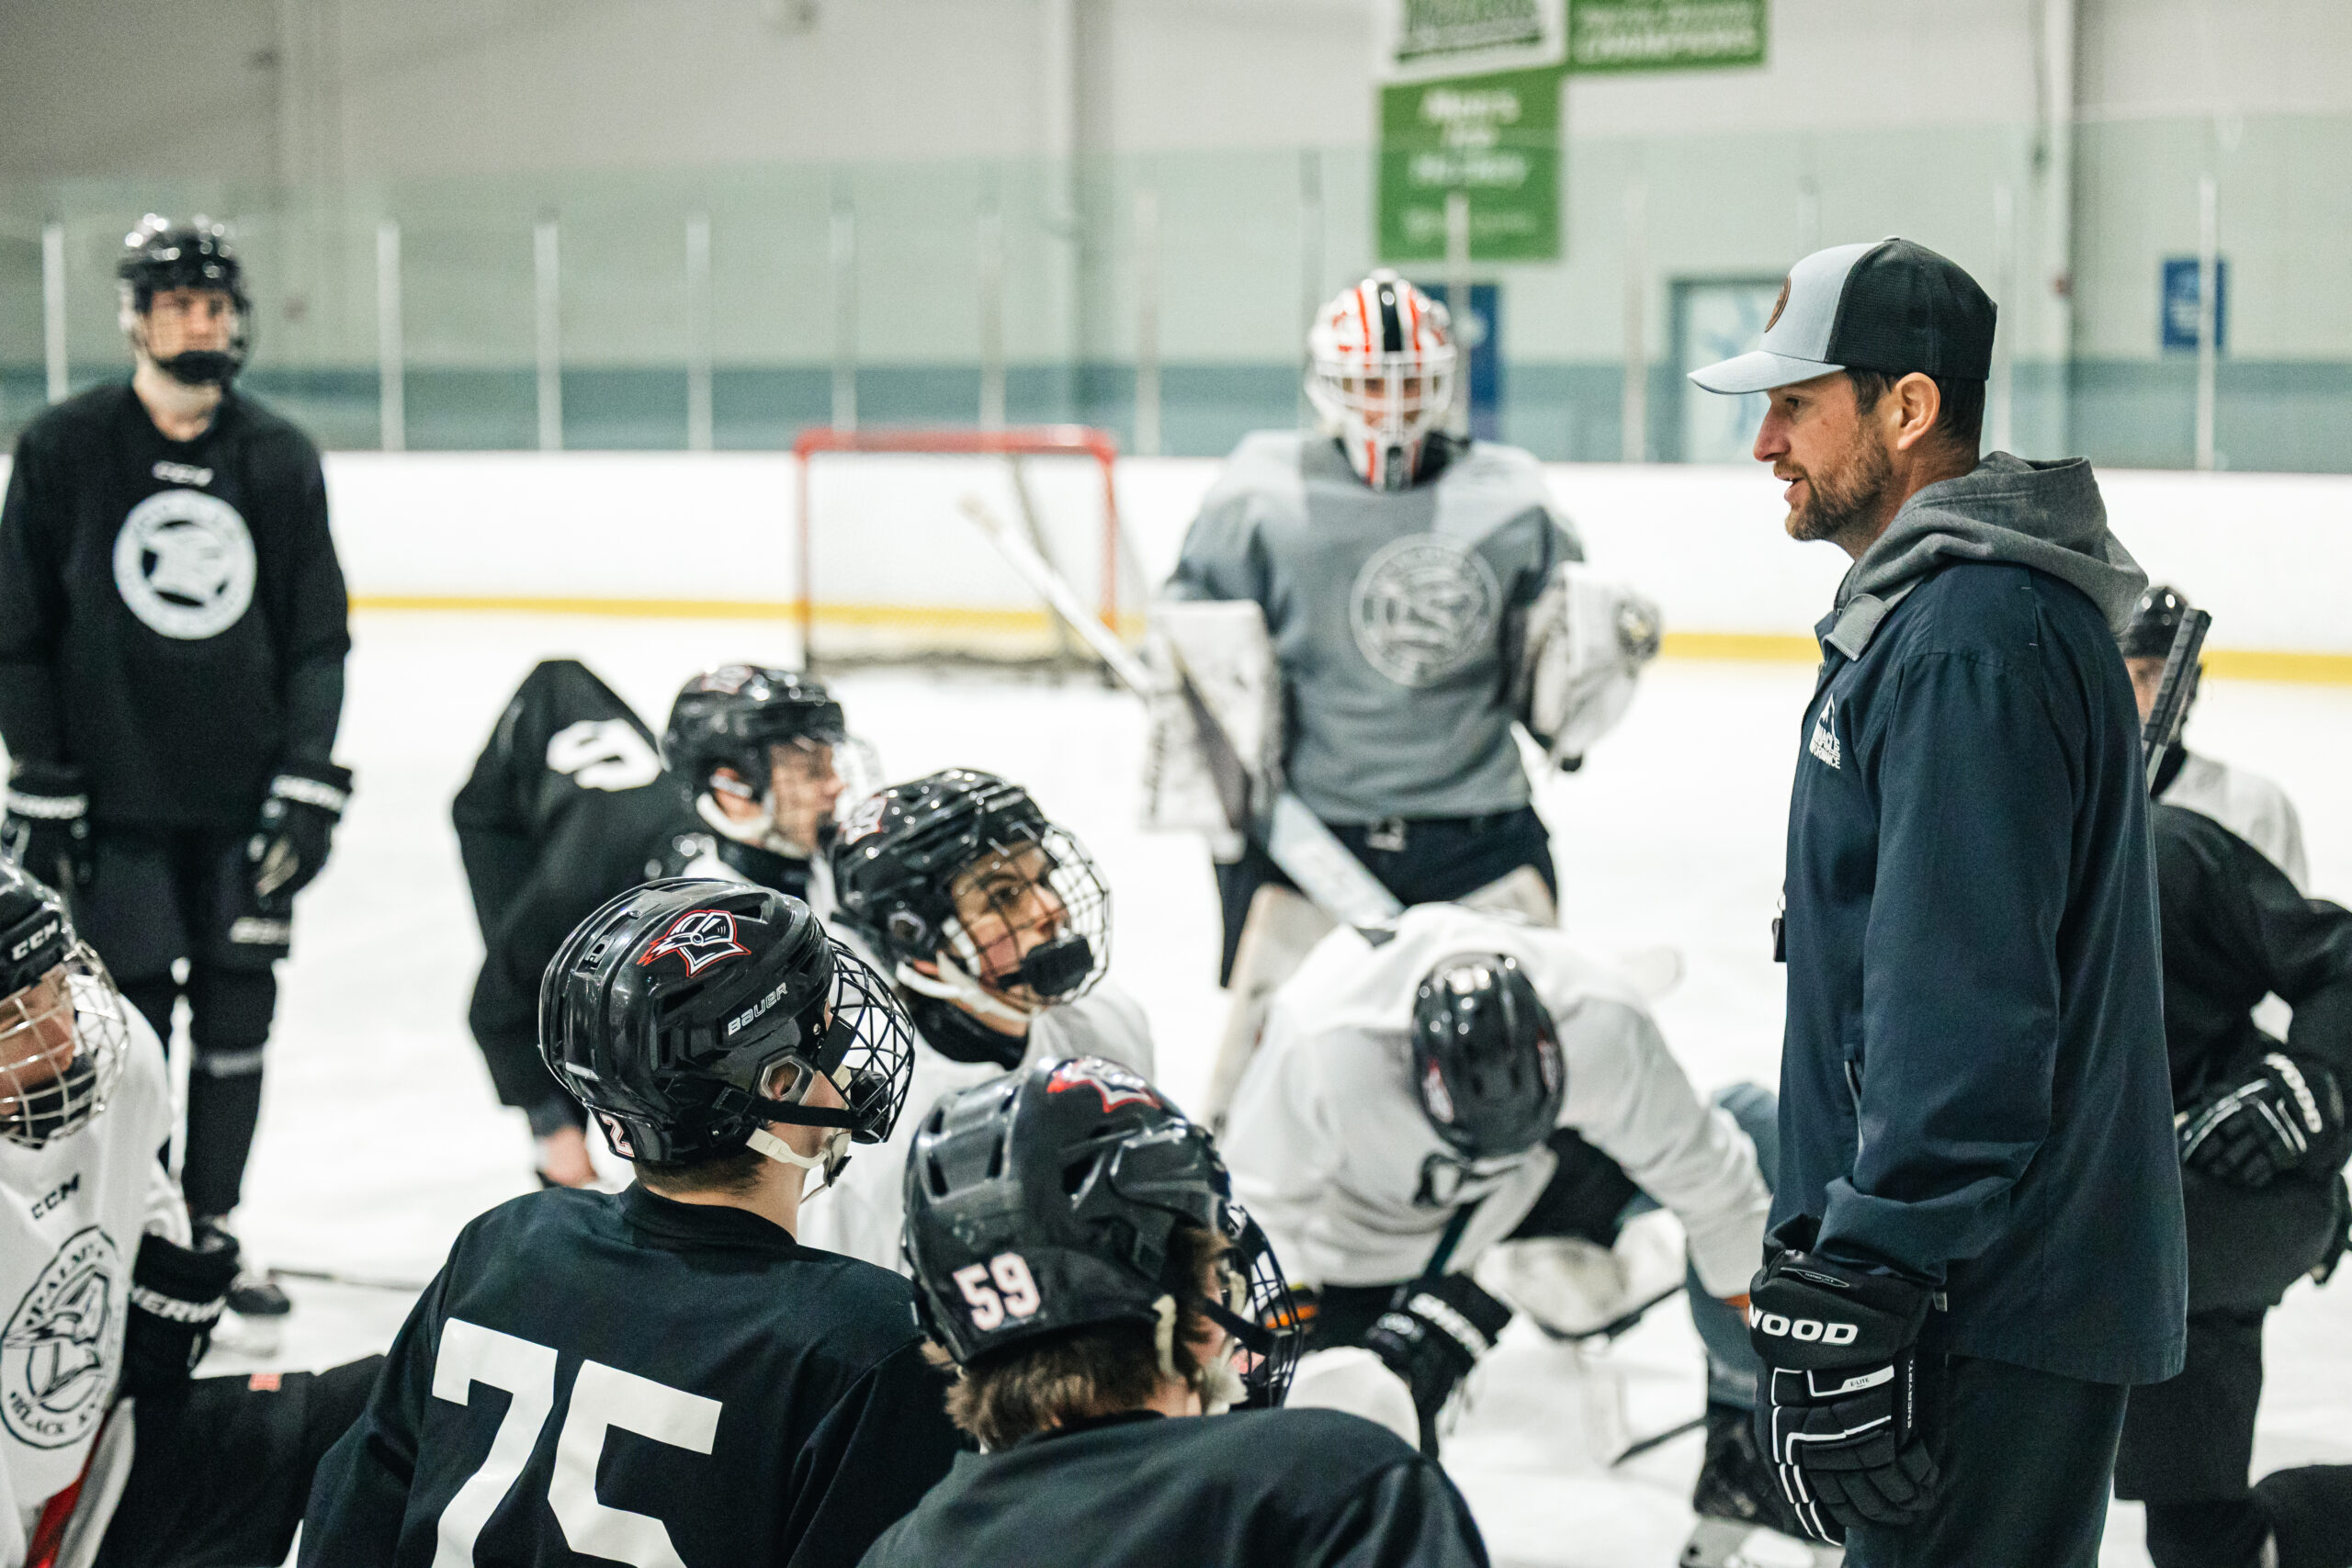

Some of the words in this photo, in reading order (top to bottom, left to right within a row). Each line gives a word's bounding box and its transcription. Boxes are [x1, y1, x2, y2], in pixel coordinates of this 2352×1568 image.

[12, 919, 58, 961] CCM
[728, 982, 788, 1036] BAUER
[31, 1173, 80, 1220] CCM
[952, 1251, 1041, 1331] 59
[432, 1316, 723, 1568] 75
